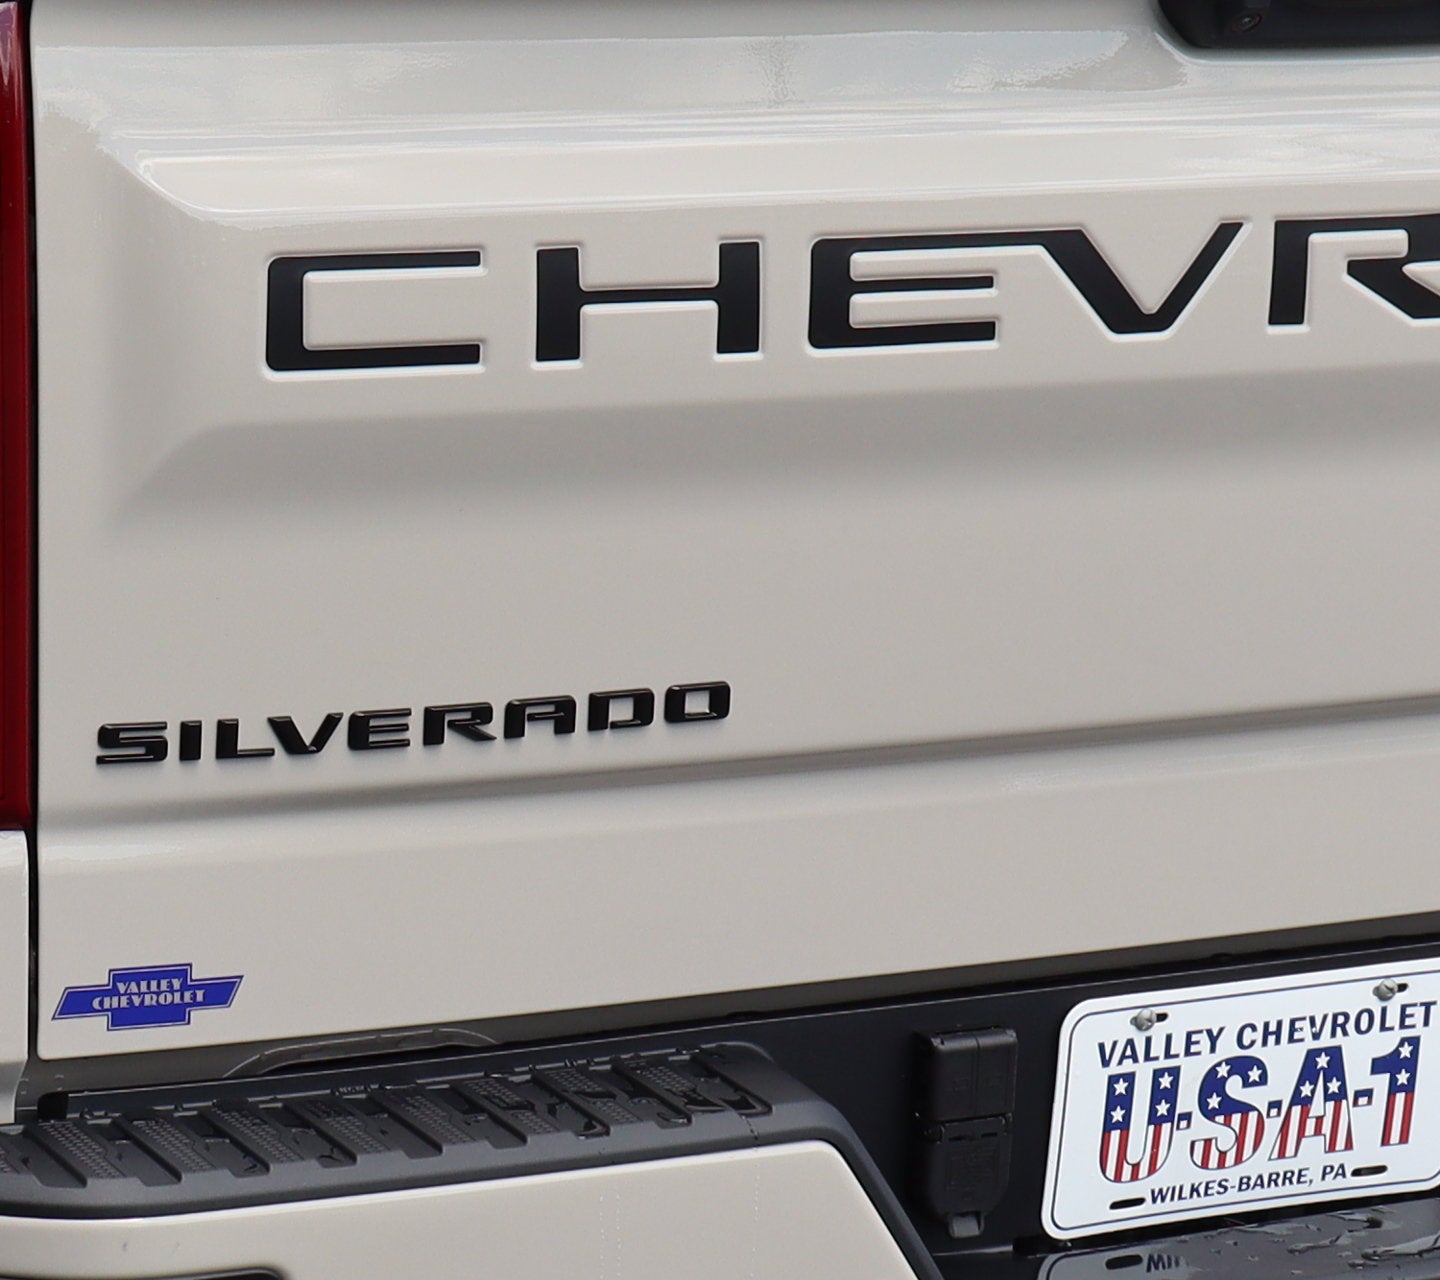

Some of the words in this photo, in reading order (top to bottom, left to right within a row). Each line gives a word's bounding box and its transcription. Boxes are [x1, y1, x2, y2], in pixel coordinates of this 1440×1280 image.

[95, 680, 732, 765] SILVERADO
[91, 989, 207, 1011] CHEVROLET
[116, 977, 184, 995] VALLEY
[1097, 1026, 1226, 1068] VALLEY
[1235, 1000, 1438, 1051] CHEVROLET
[1149, 1167, 1314, 1205] WILKES-BARRE,
[1320, 1163, 1347, 1182] PA
